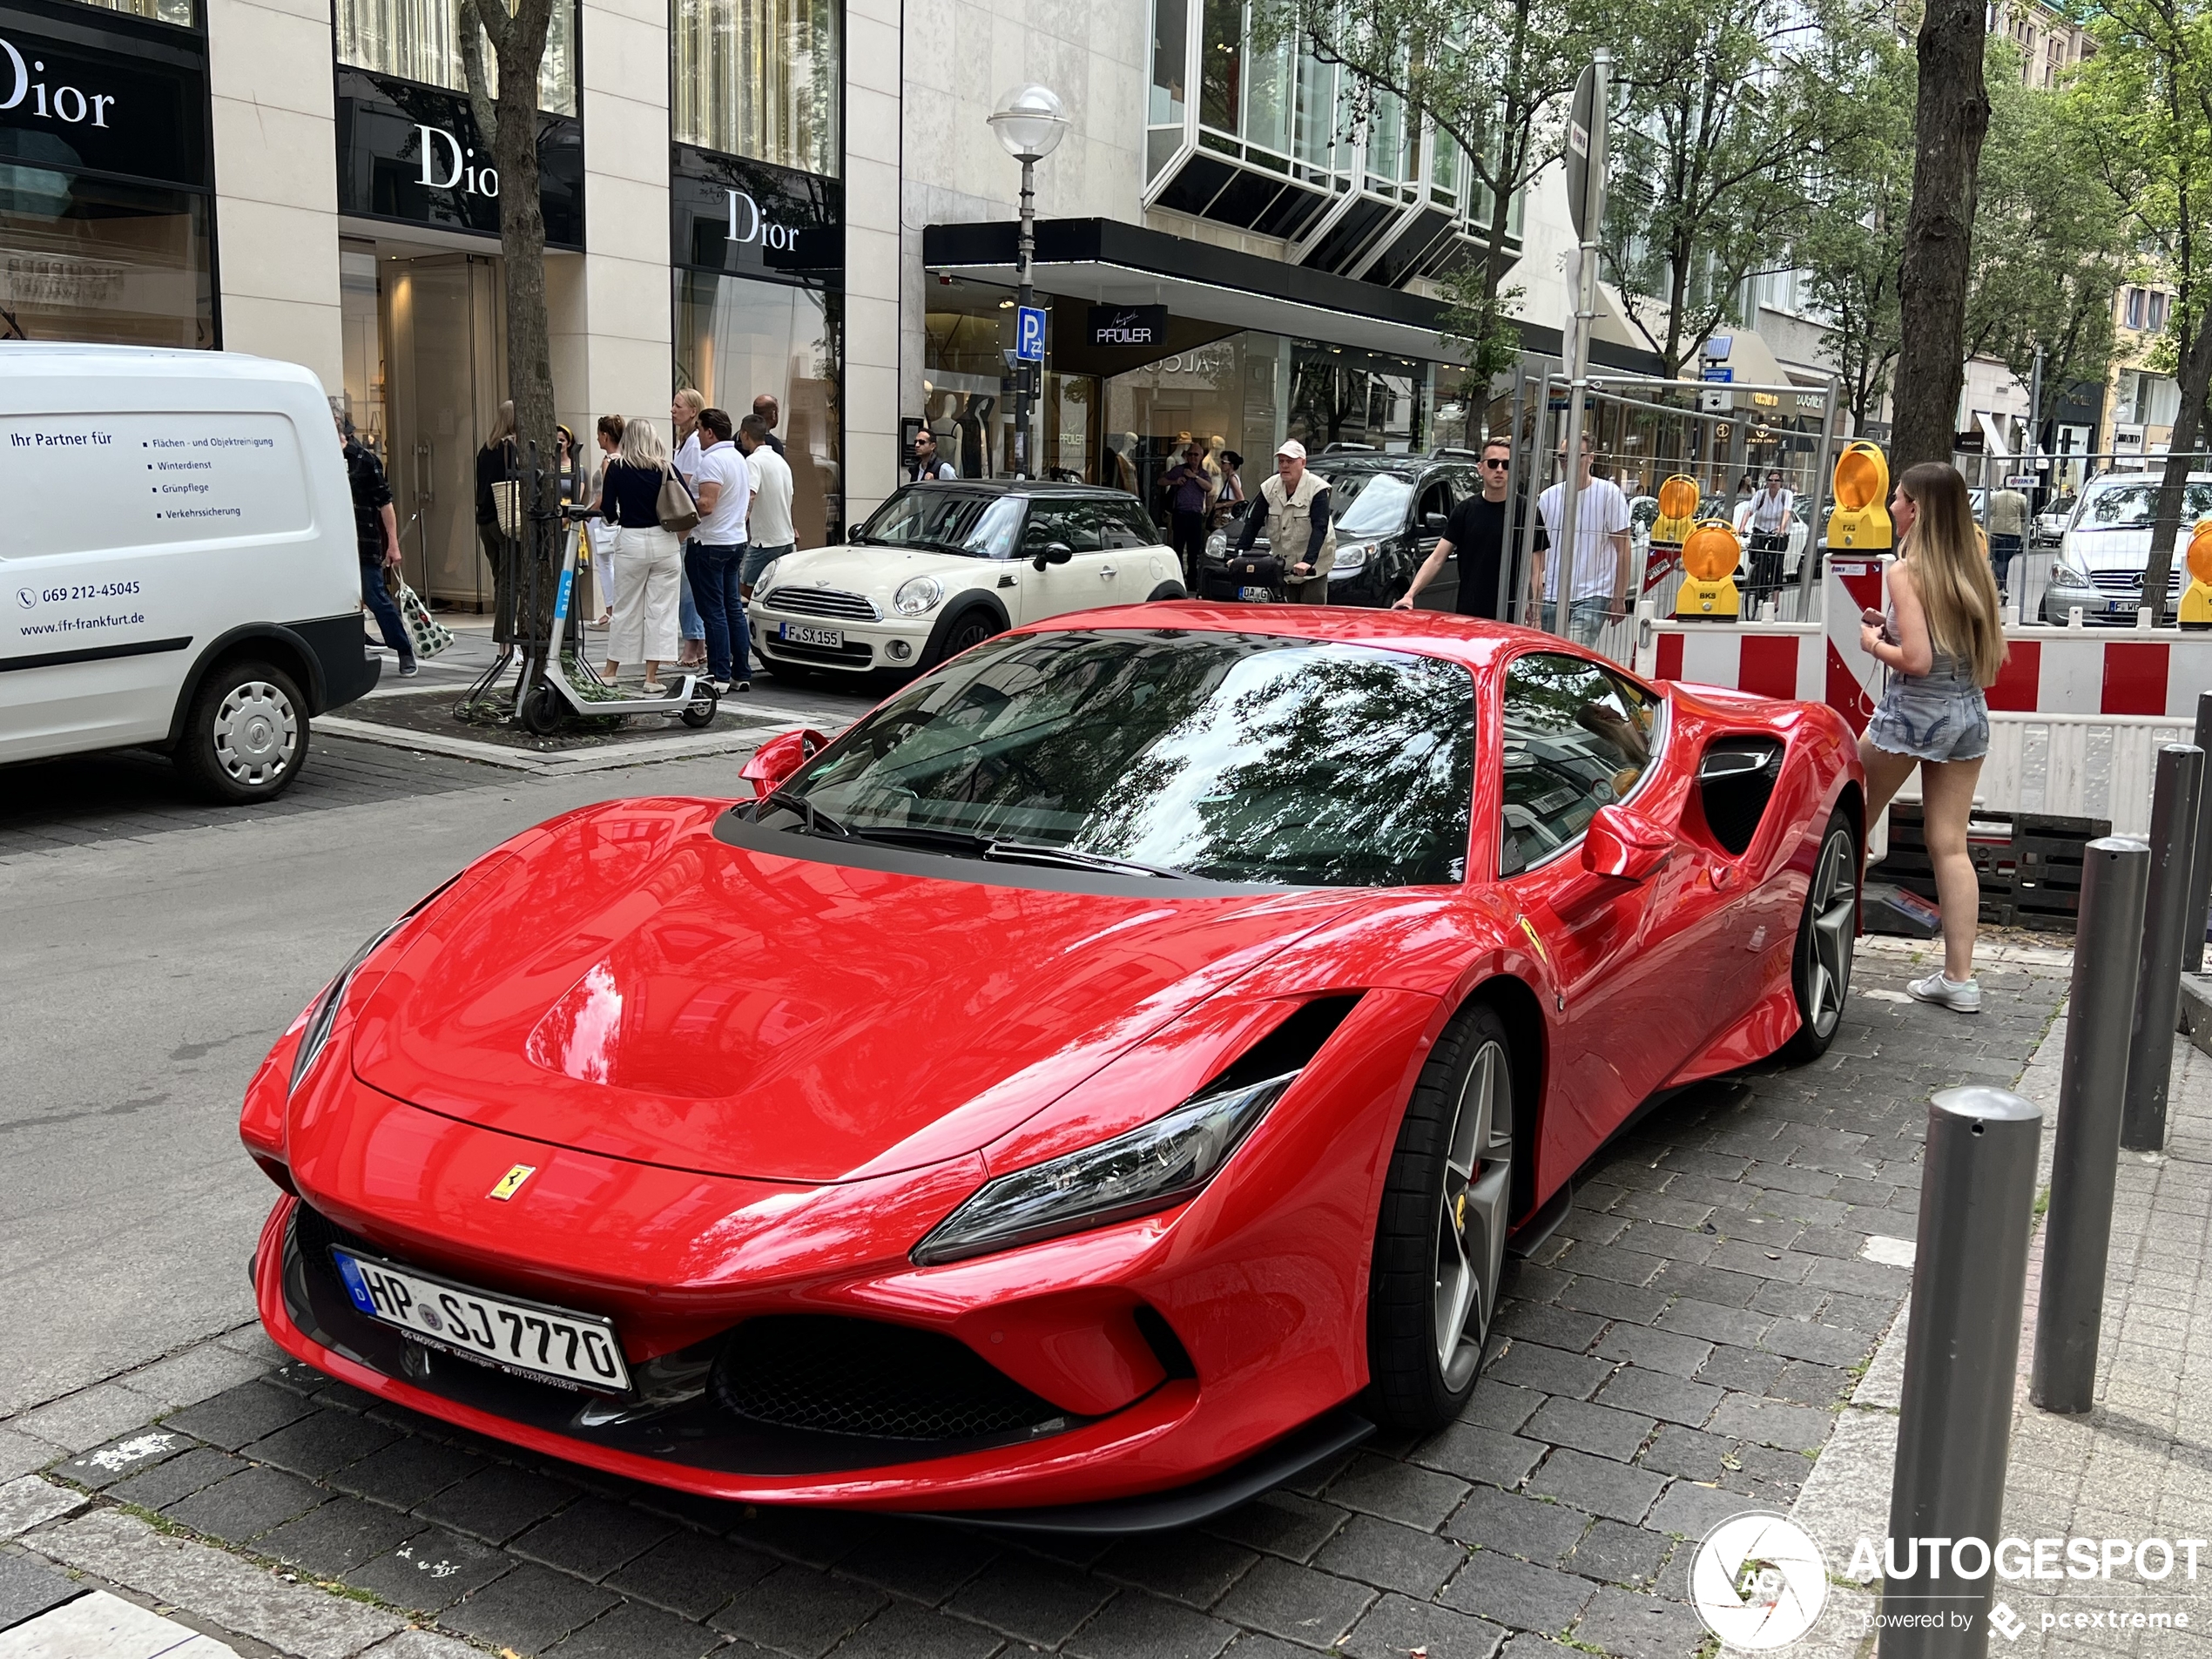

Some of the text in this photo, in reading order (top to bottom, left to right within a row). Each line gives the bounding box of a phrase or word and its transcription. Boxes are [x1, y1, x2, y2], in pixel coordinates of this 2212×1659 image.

[415, 124, 499, 197] Dio
[725, 189, 799, 251] Dior
[1023, 314, 1039, 353] P
[1096, 327, 1151, 343] PFÜLLER
[10, 431, 112, 446] Ihr Partner für
[152, 439, 185, 448] Flächen
[192, 438, 209, 447] und
[210, 437, 273, 448] Objektreinigung
[157, 461, 212, 470] Winterdienst
[162, 483, 209, 494] Grünpflege
[165, 507, 241, 518] Verkehrssicherung
[43, 581, 140, 602] 069 212-45045
[20, 612, 145, 636] www.ffr-frankfurt.de
[789, 626, 838, 644] F SX 155
[361, 1267, 413, 1320] HP
[439, 1293, 496, 1351] SJ
[497, 1310, 617, 1379] 7770
